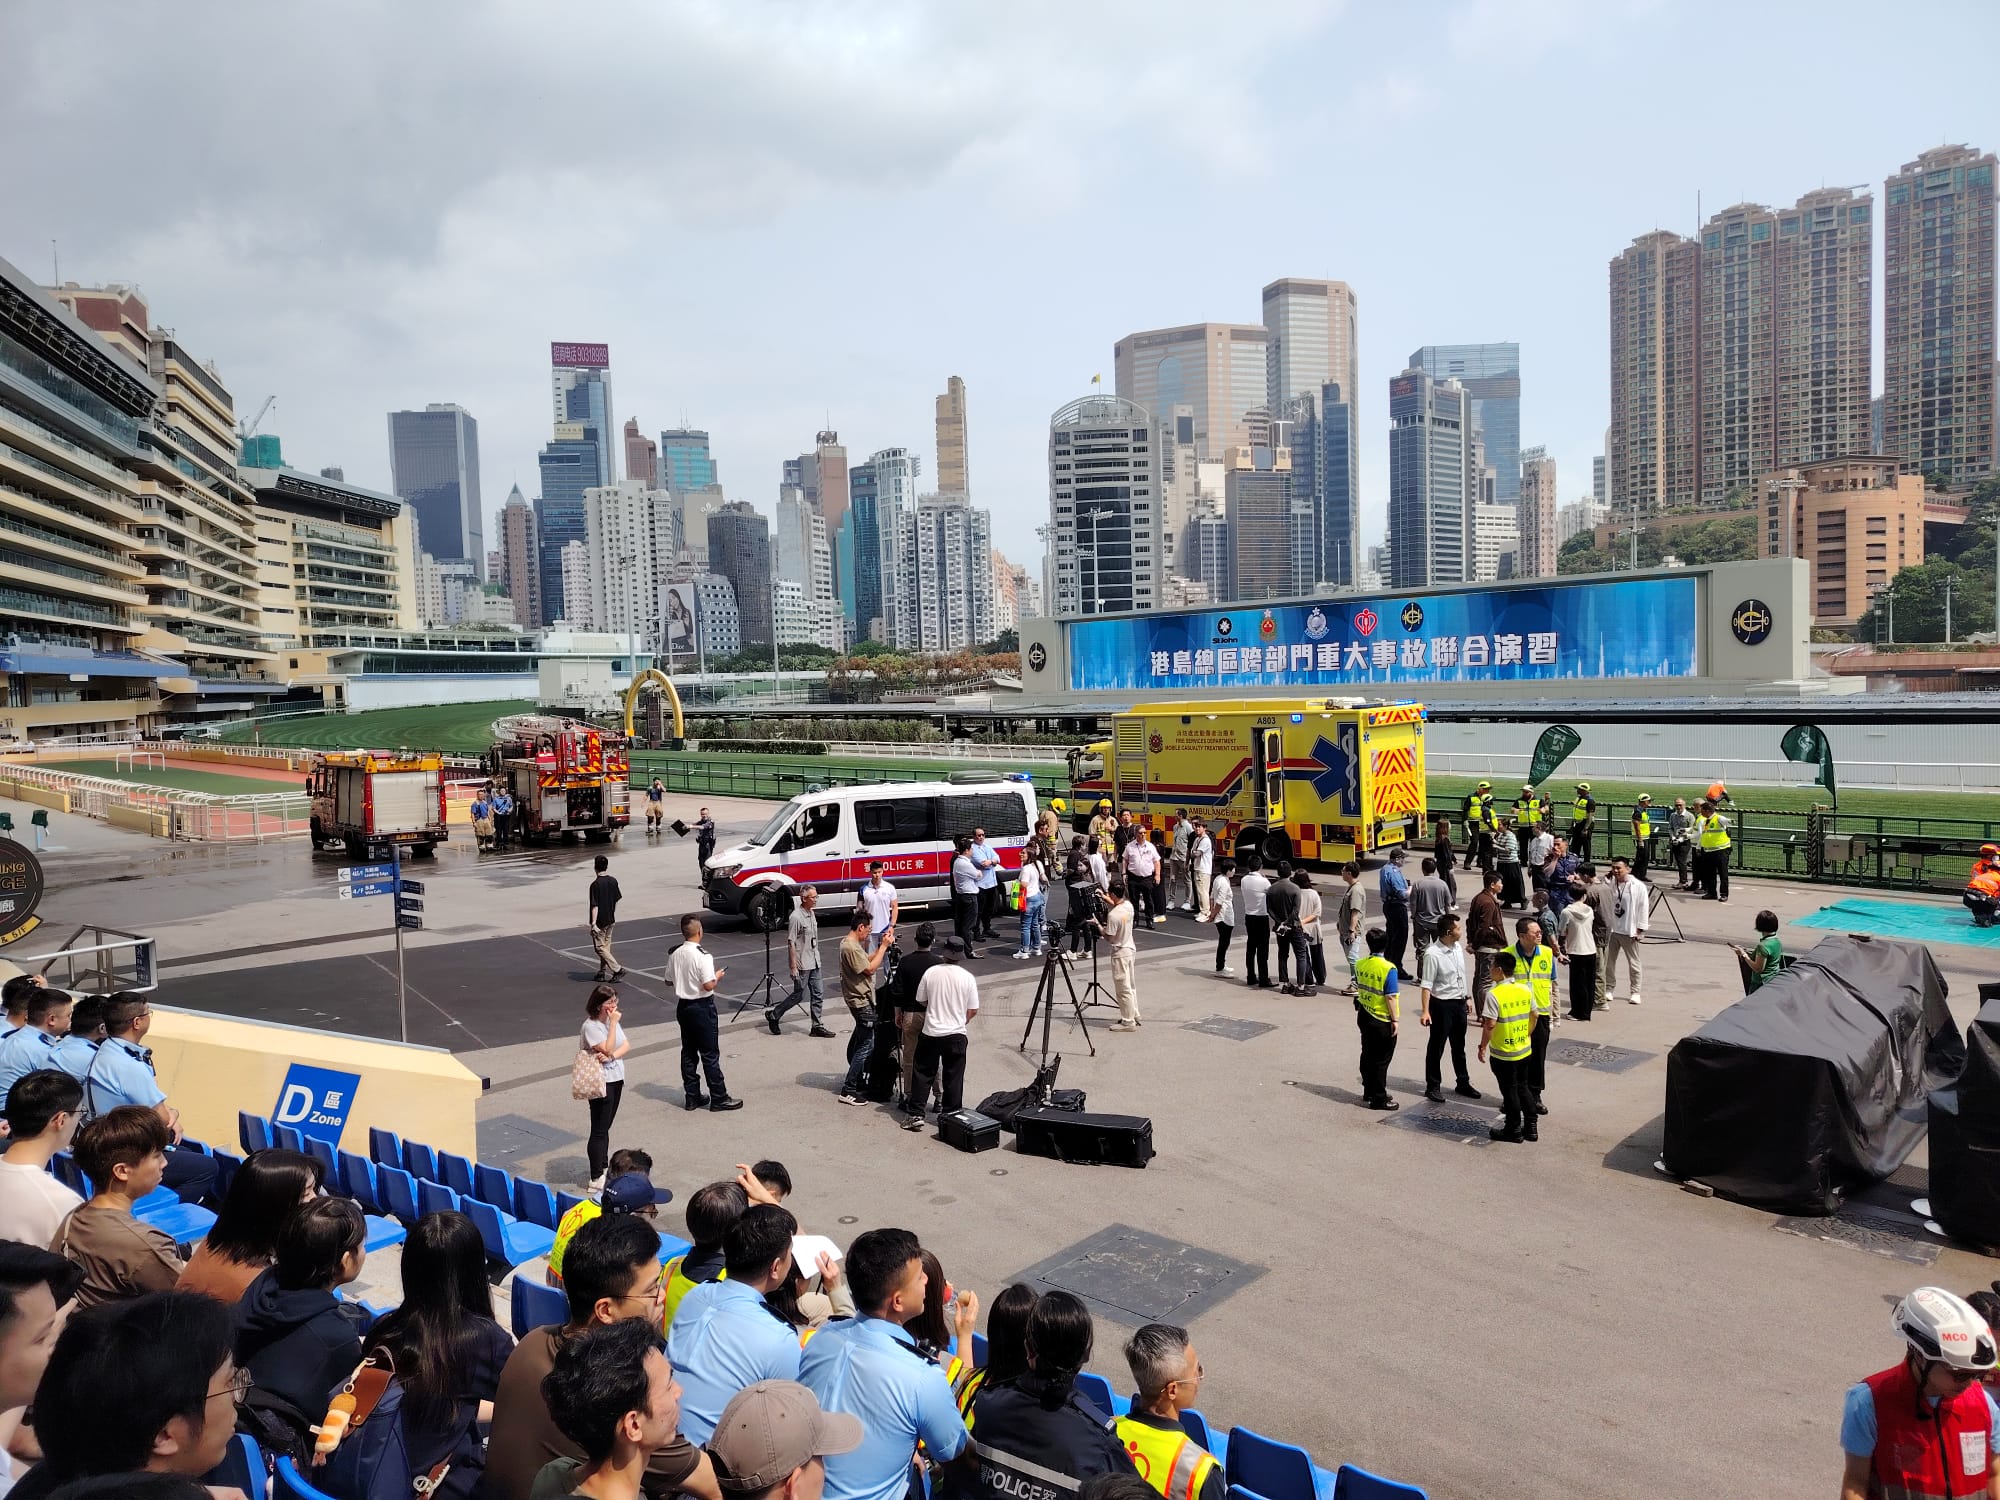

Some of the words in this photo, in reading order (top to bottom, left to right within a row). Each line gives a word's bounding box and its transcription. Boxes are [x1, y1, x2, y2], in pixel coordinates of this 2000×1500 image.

[1150, 632, 1558, 677] 港島總區跨部門重大事故聯合演習
[1257, 717, 1276, 725] A803
[1188, 807, 1230, 817] AMBULANCE
[882, 860, 912, 871] OLICE
[277, 1084, 314, 1123] D
[323, 1090, 343, 1110] 區
[309, 1110, 342, 1127] Zone
[1942, 1333, 1968, 1342] MCO
[986, 1467, 1042, 1500] POLICE
